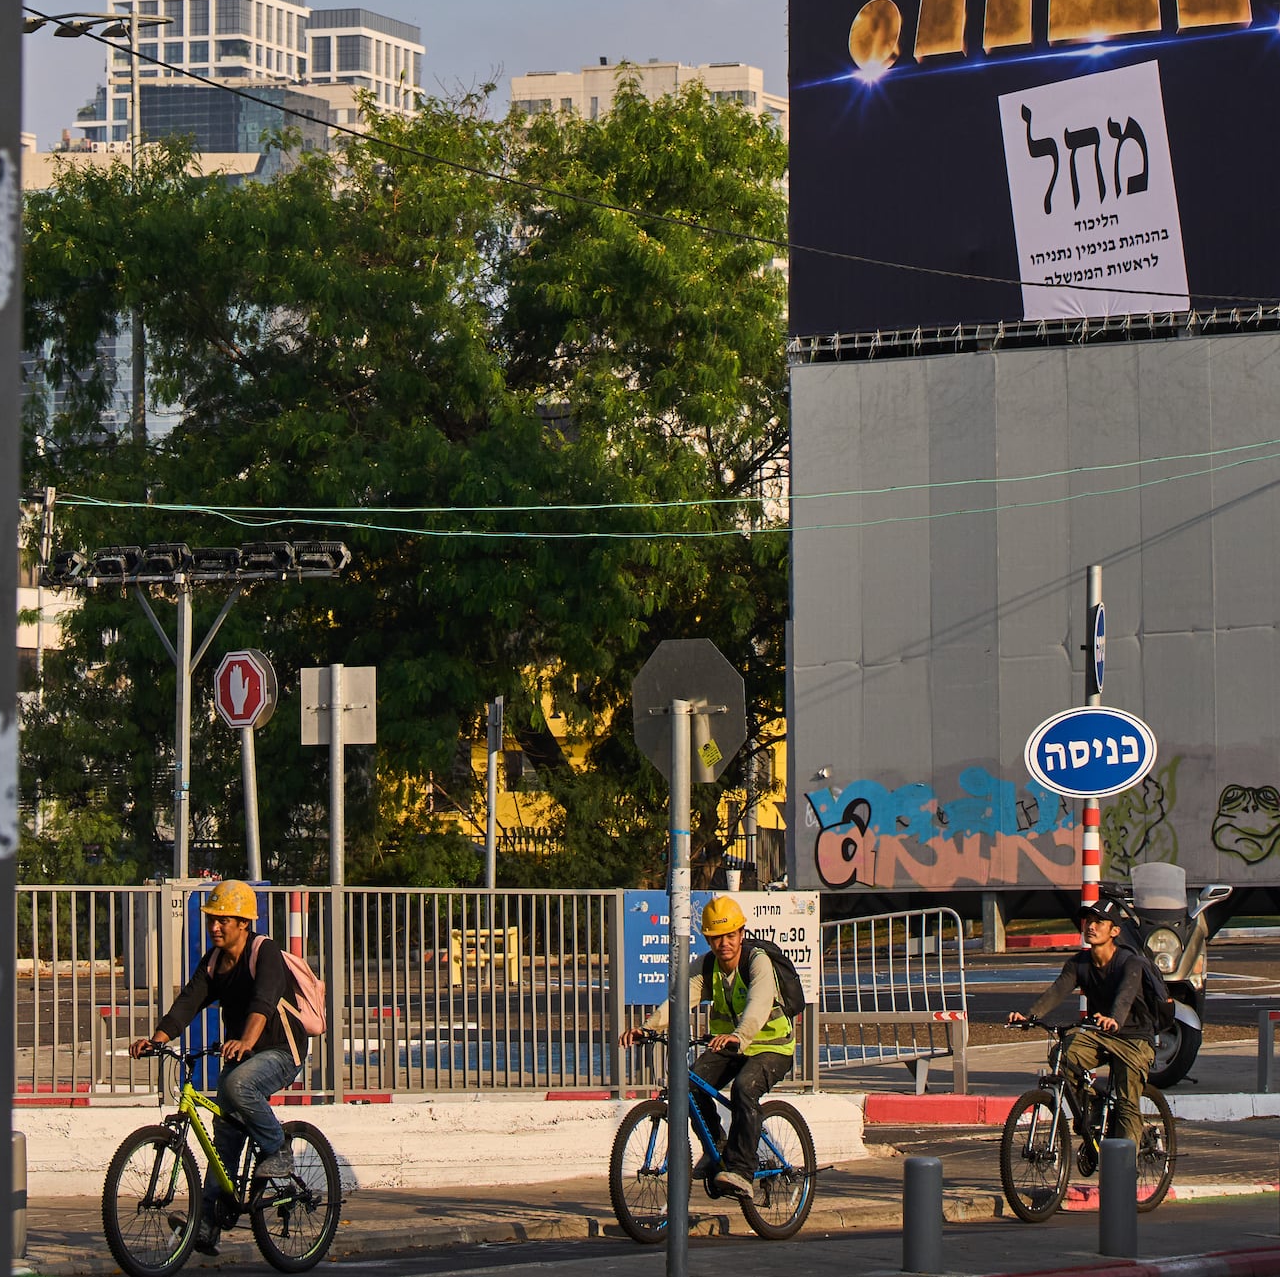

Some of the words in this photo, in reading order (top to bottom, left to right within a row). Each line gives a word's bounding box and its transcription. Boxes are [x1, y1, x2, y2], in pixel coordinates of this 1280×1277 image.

[1020, 103, 1149, 215] מחל
[1074, 213, 1119, 233] הליכוד
[1119, 227, 1170, 250] בהנהגת
[1030, 246, 1072, 266] נתניהו
[1075, 238, 1116, 261] בנימין
[1107, 253, 1159, 277] לראשות
[1044, 267, 1103, 286] הממשלה
[1044, 734, 1140, 772] כניסה
[753, 904, 781, 917] מחירון:
[642, 934, 659, 946] ניתן
[638, 971, 665, 984] בלבד!
